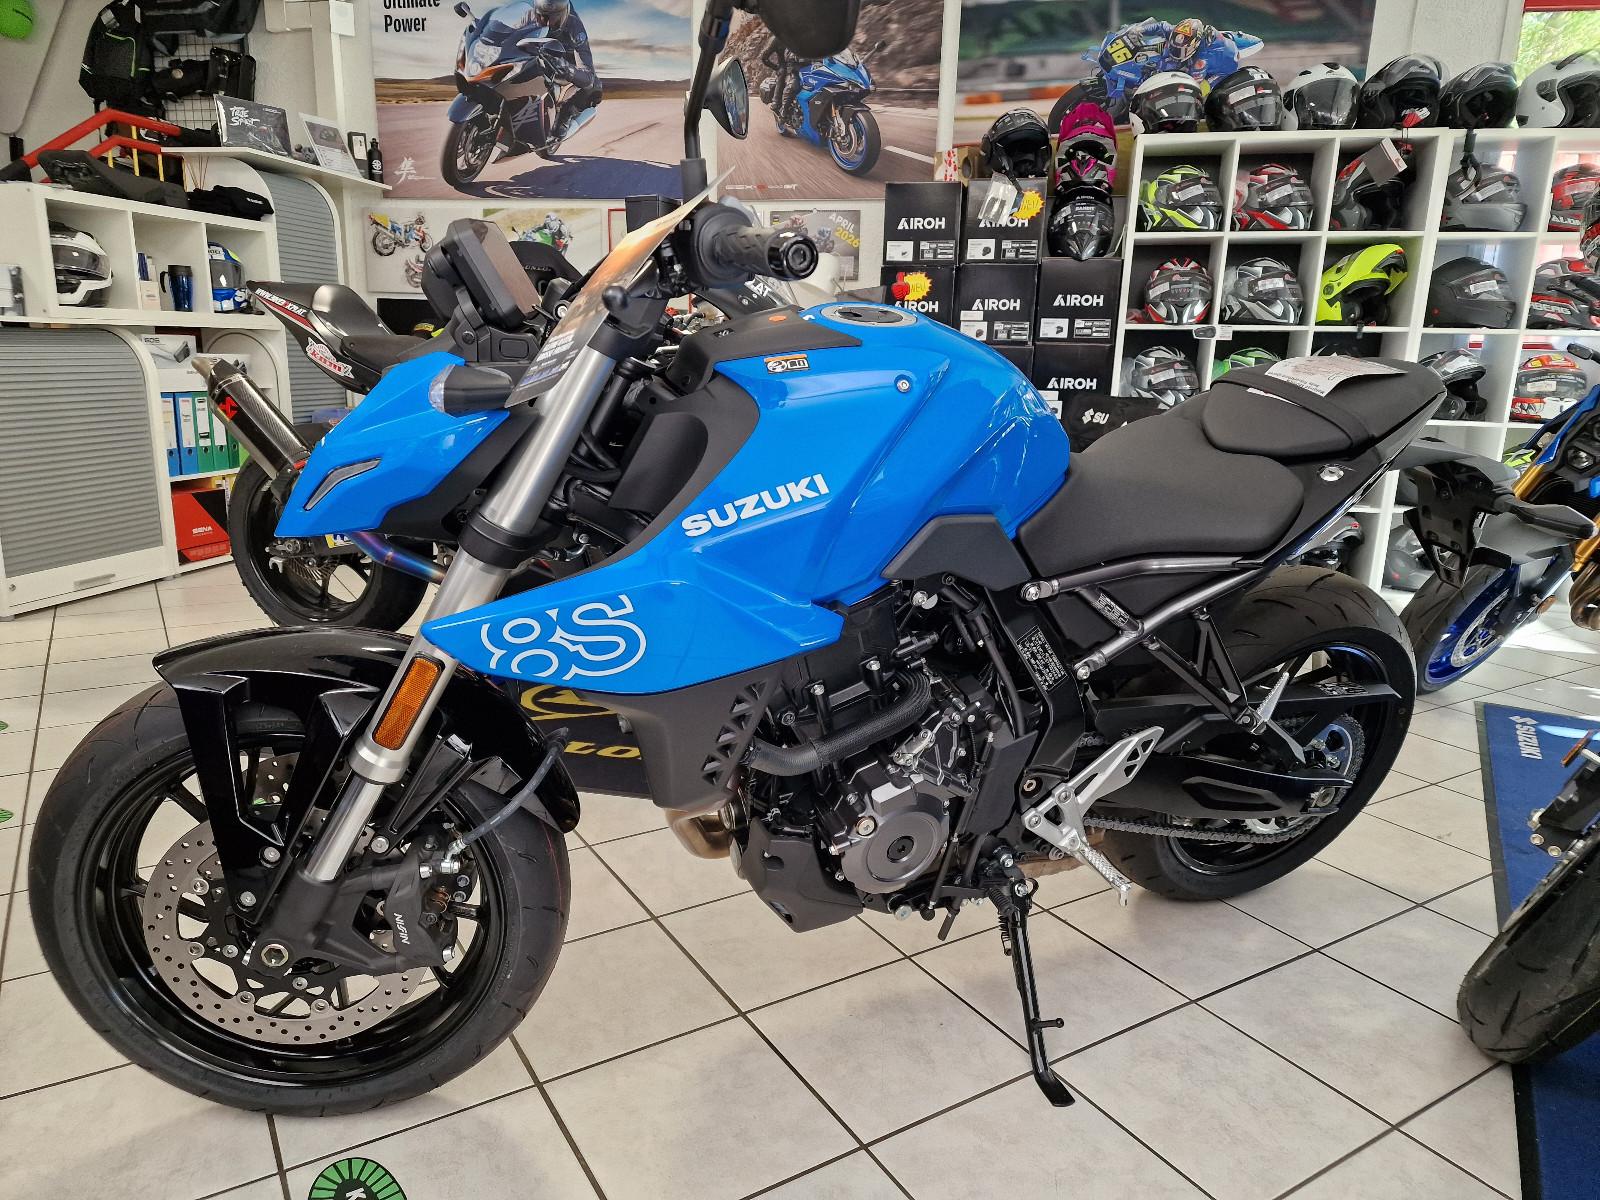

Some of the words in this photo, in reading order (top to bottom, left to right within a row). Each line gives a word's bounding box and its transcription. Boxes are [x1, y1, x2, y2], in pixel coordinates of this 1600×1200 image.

[384, 14, 427, 33] Power
[1107, 39, 1133, 64] 36
[828, 212, 855, 234] APRIL
[896, 216, 946, 230] AIROH
[834, 226, 861, 248] 2026
[910, 282, 926, 293] NEU
[971, 298, 1021, 311] AIROH
[1053, 294, 1104, 307] AIROH
[1046, 377, 1098, 390] AIROH
[681, 473, 830, 537] SUZUKI
[192, 526, 213, 535] SENA
[1515, 723, 1543, 760] SUZUKI
[393, 912, 411, 945] NISSIN
